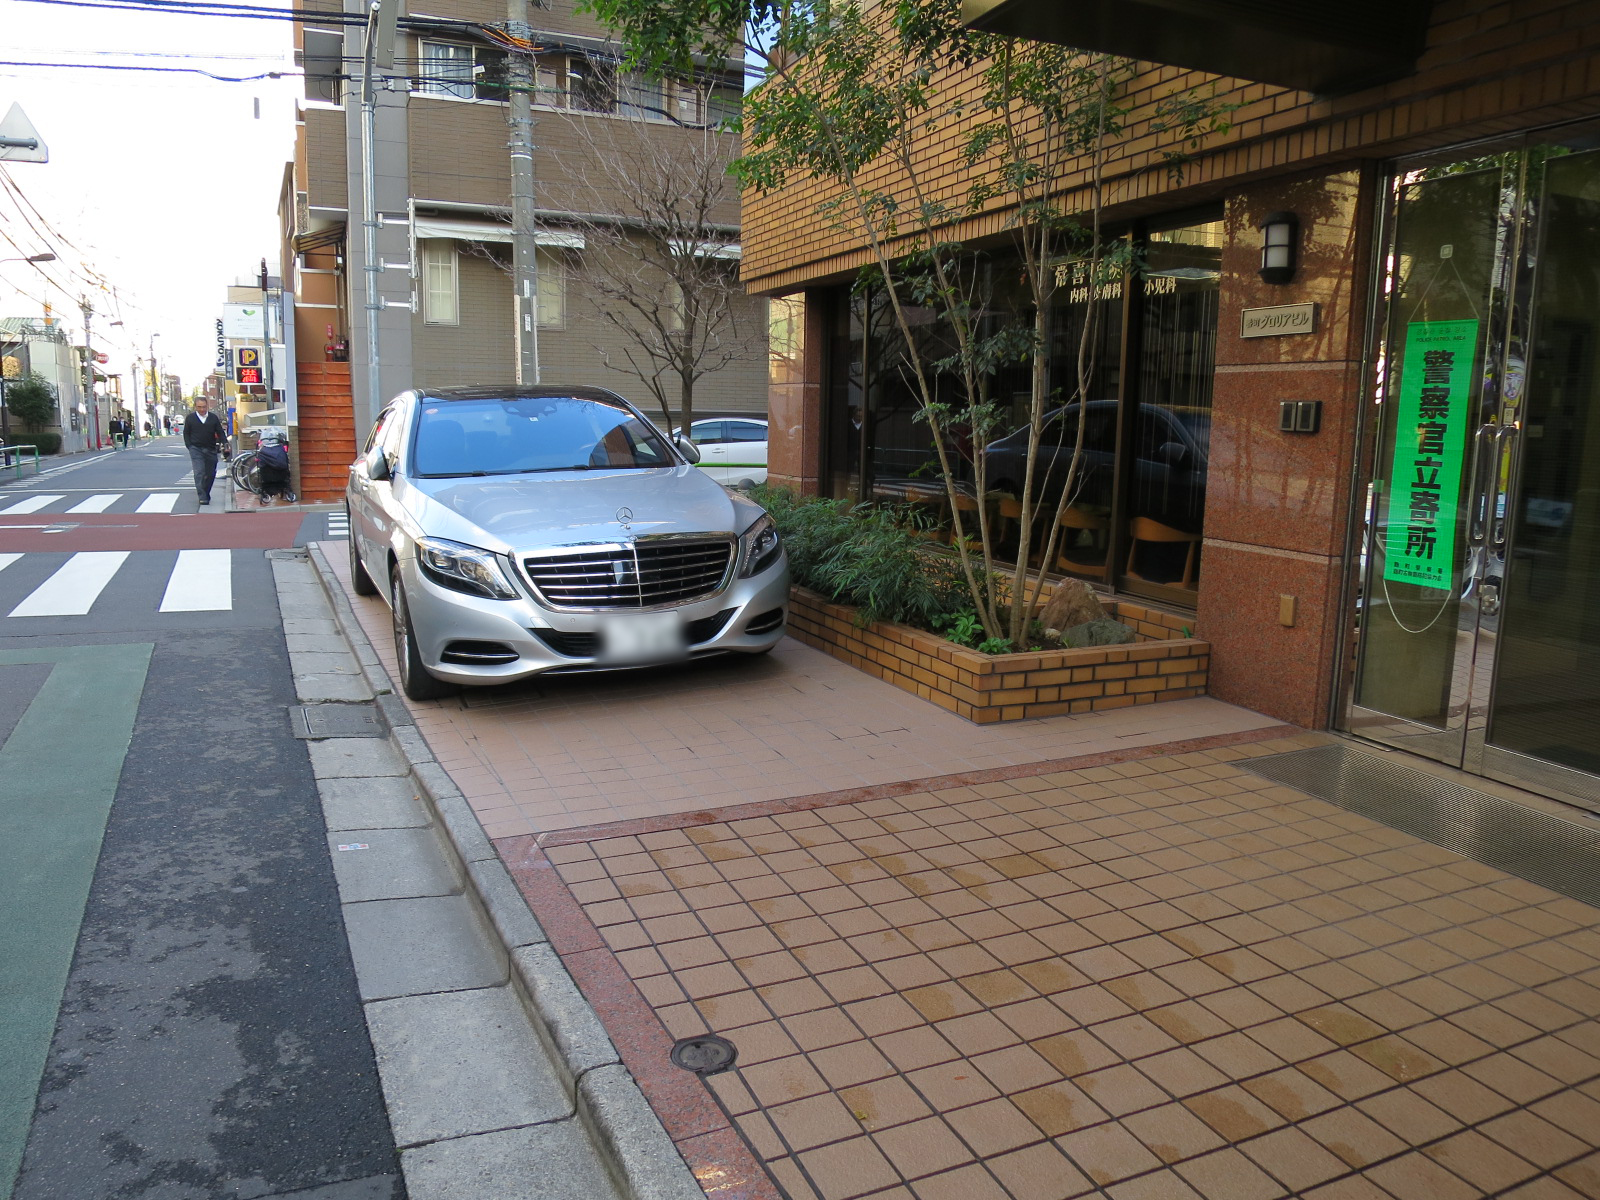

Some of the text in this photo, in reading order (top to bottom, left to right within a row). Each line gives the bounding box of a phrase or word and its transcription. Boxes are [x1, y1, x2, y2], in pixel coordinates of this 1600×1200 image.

[1070, 287, 1088, 304] 内科
[1144, 277, 1177, 296] 小児科
[216, 318, 225, 356] KOKUYO
[242, 349, 256, 365] P
[1404, 350, 1455, 560] 警察官立寄所
